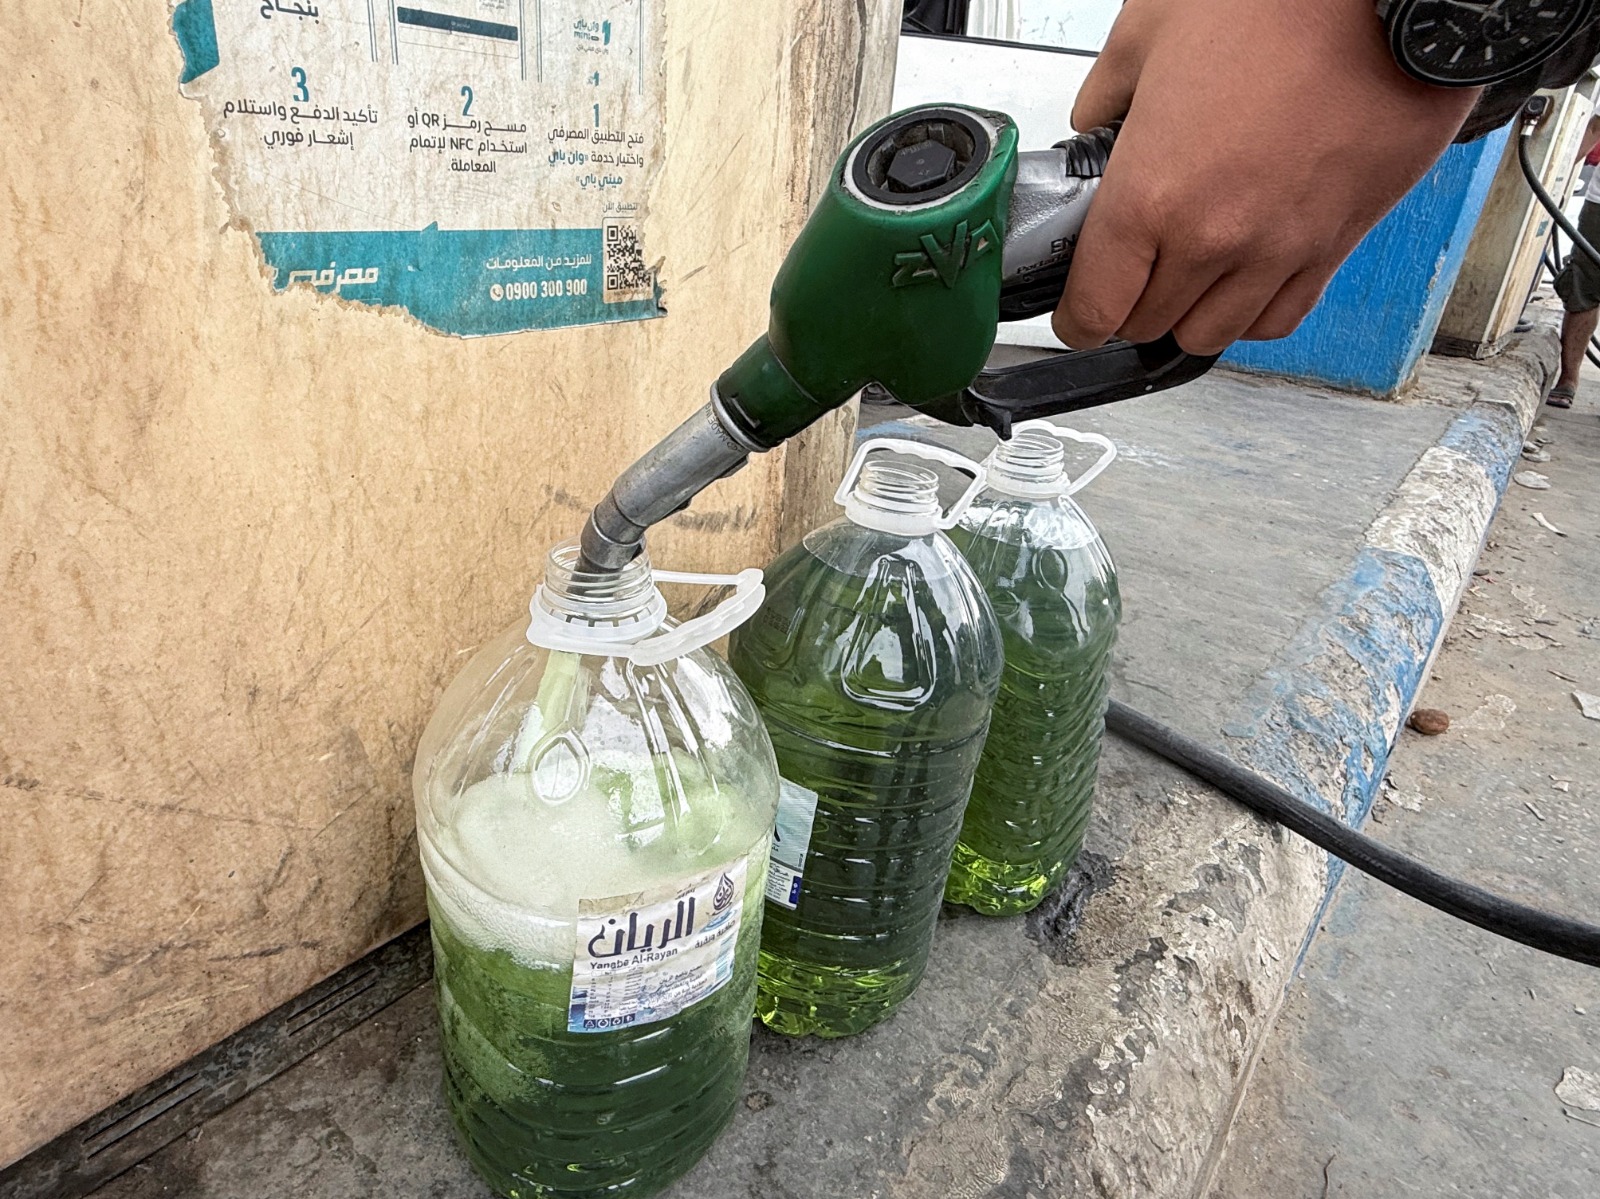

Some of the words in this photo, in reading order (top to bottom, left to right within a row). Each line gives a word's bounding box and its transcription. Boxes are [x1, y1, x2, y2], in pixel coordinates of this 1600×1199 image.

[291, 66, 309, 103] 3
[223, 99, 287, 120] واستلام
[461, 85, 474, 117] 2
[290, 104, 339, 124] الدفع
[343, 104, 378, 126] تأكيد
[407, 107, 419, 128] أو
[421, 113, 440, 129] QR
[593, 103, 600, 128] 1
[442, 114, 481, 133] رمز
[484, 121, 527, 136] مسح
[308, 129, 354, 150] إشعار
[450, 137, 474, 151] NFC
[548, 126, 590, 144] المصرفي
[591, 129, 626, 144] التطبيق
[627, 132, 644, 149] فتح
[409, 135, 446, 154] لإتمام
[478, 140, 528, 156] استخدام
[591, 151, 615, 164] خدمة
[615, 153, 644, 168] واختيار
[598, 174, 623, 191] ميني
[486, 254, 544, 271] المعلومات
[545, 256, 562, 270] من
[563, 253, 592, 269] للمزيد
[505, 281, 537, 300] 0900
[540, 280, 563, 297] 300
[566, 278, 588, 296] 900
[632, 948, 678, 966] Al-Rayan
